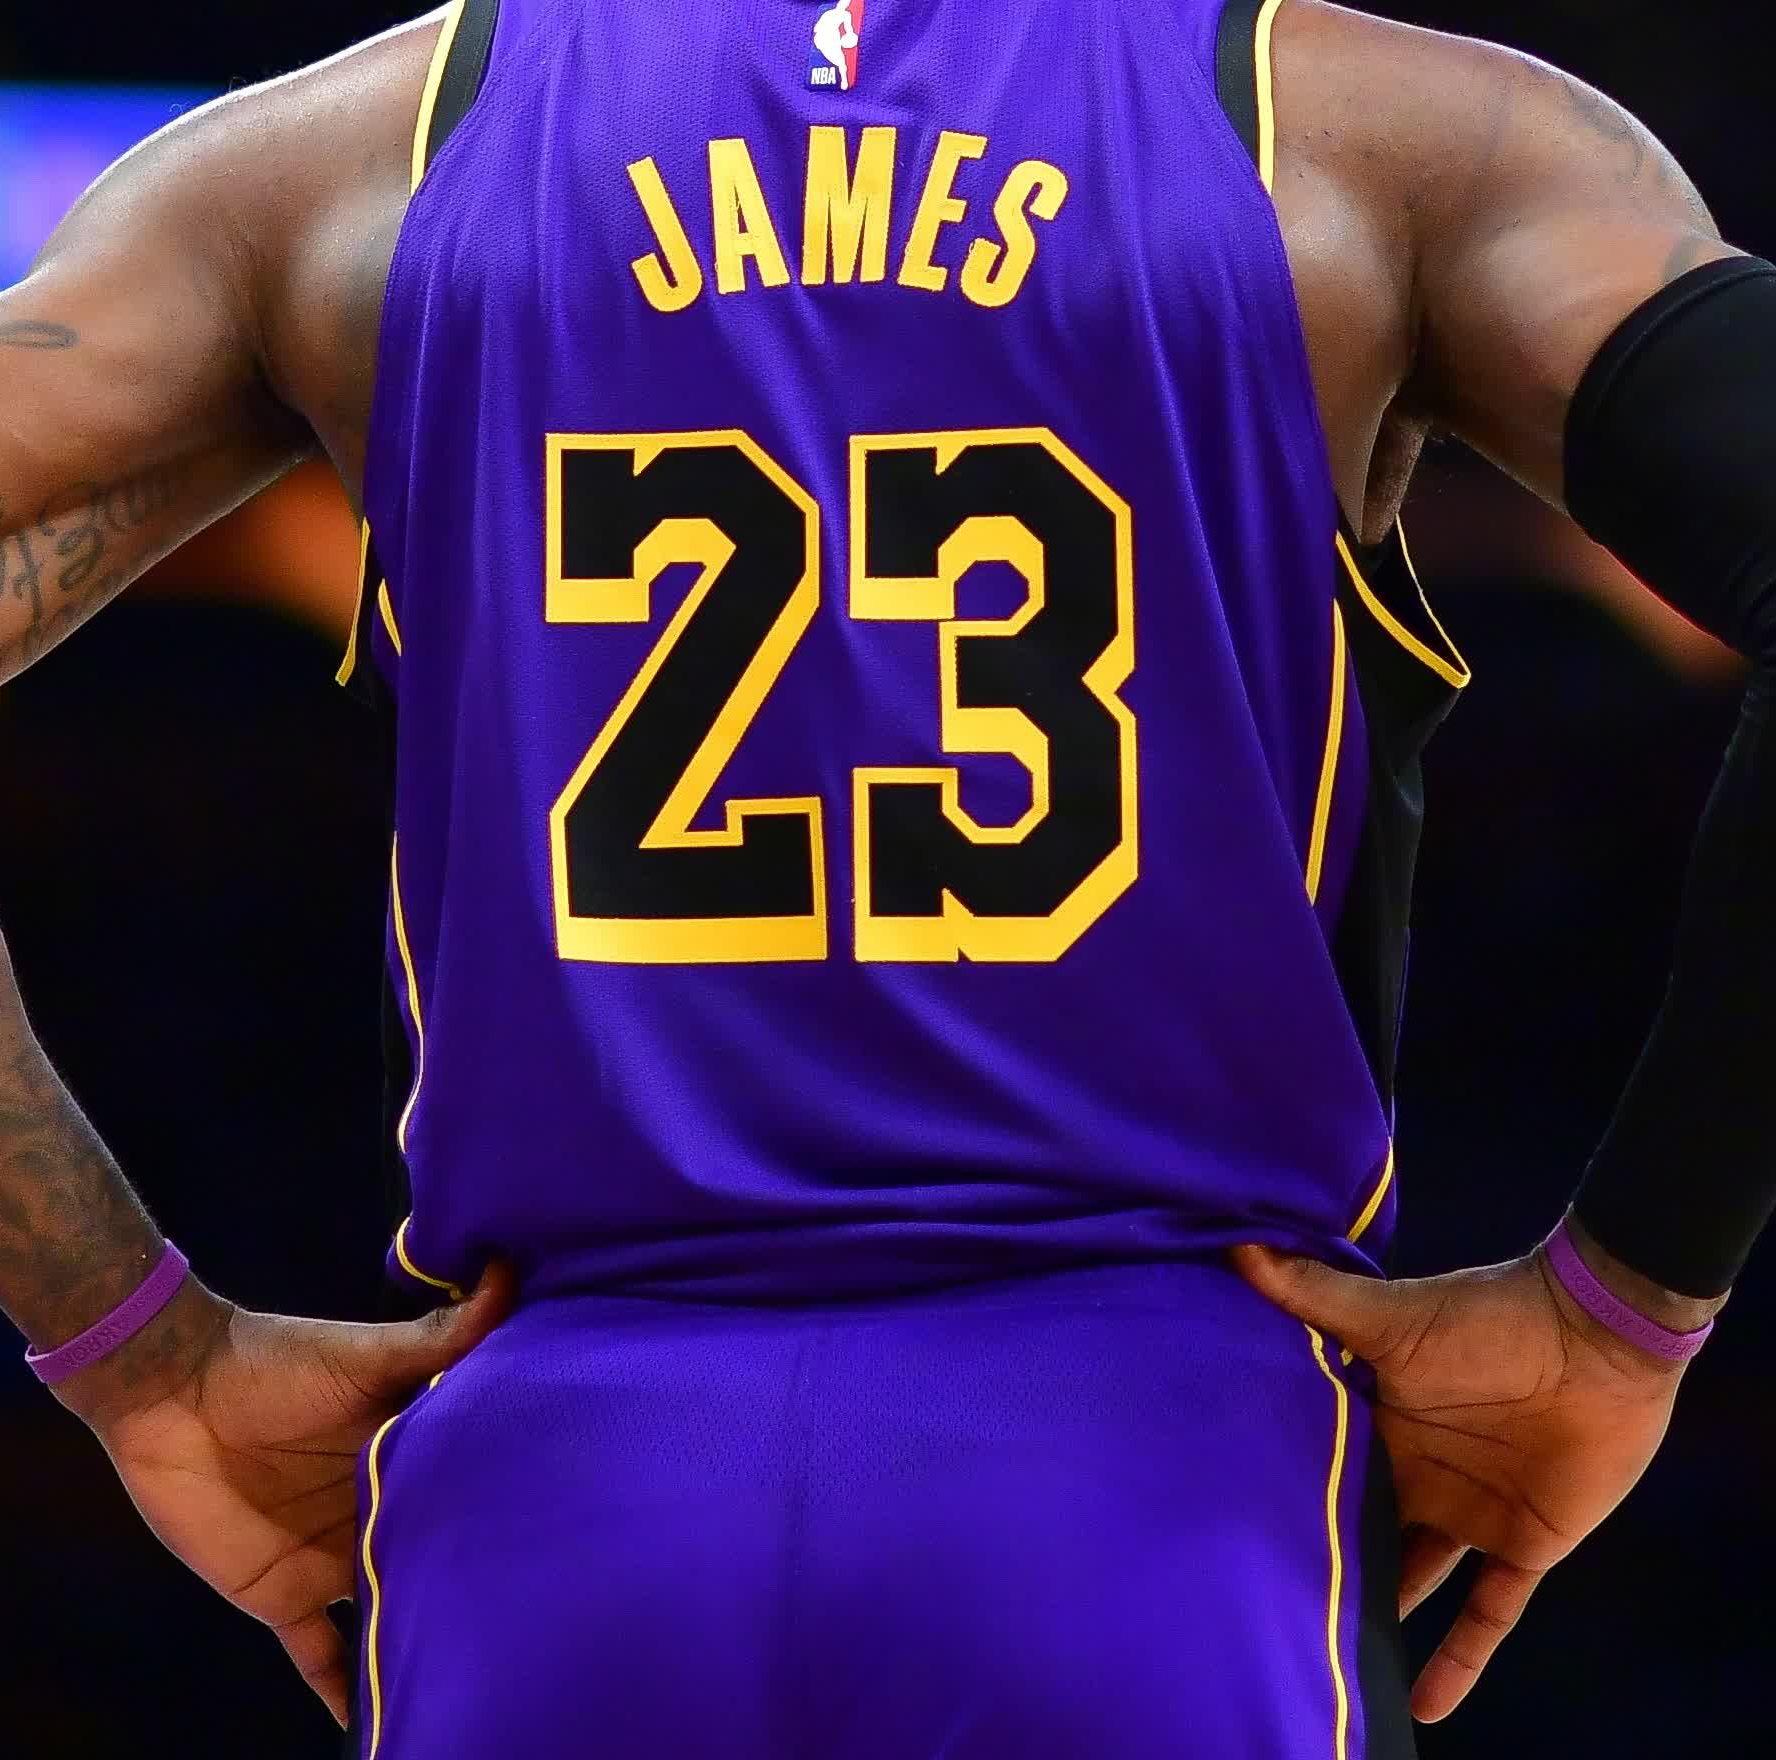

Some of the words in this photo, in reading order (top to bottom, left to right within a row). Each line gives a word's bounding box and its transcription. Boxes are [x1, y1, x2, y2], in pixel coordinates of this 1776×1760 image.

[810, 66, 837, 85] NBA
[627, 125, 1069, 313] JAMES
[544, 426, 1139, 964] 23
